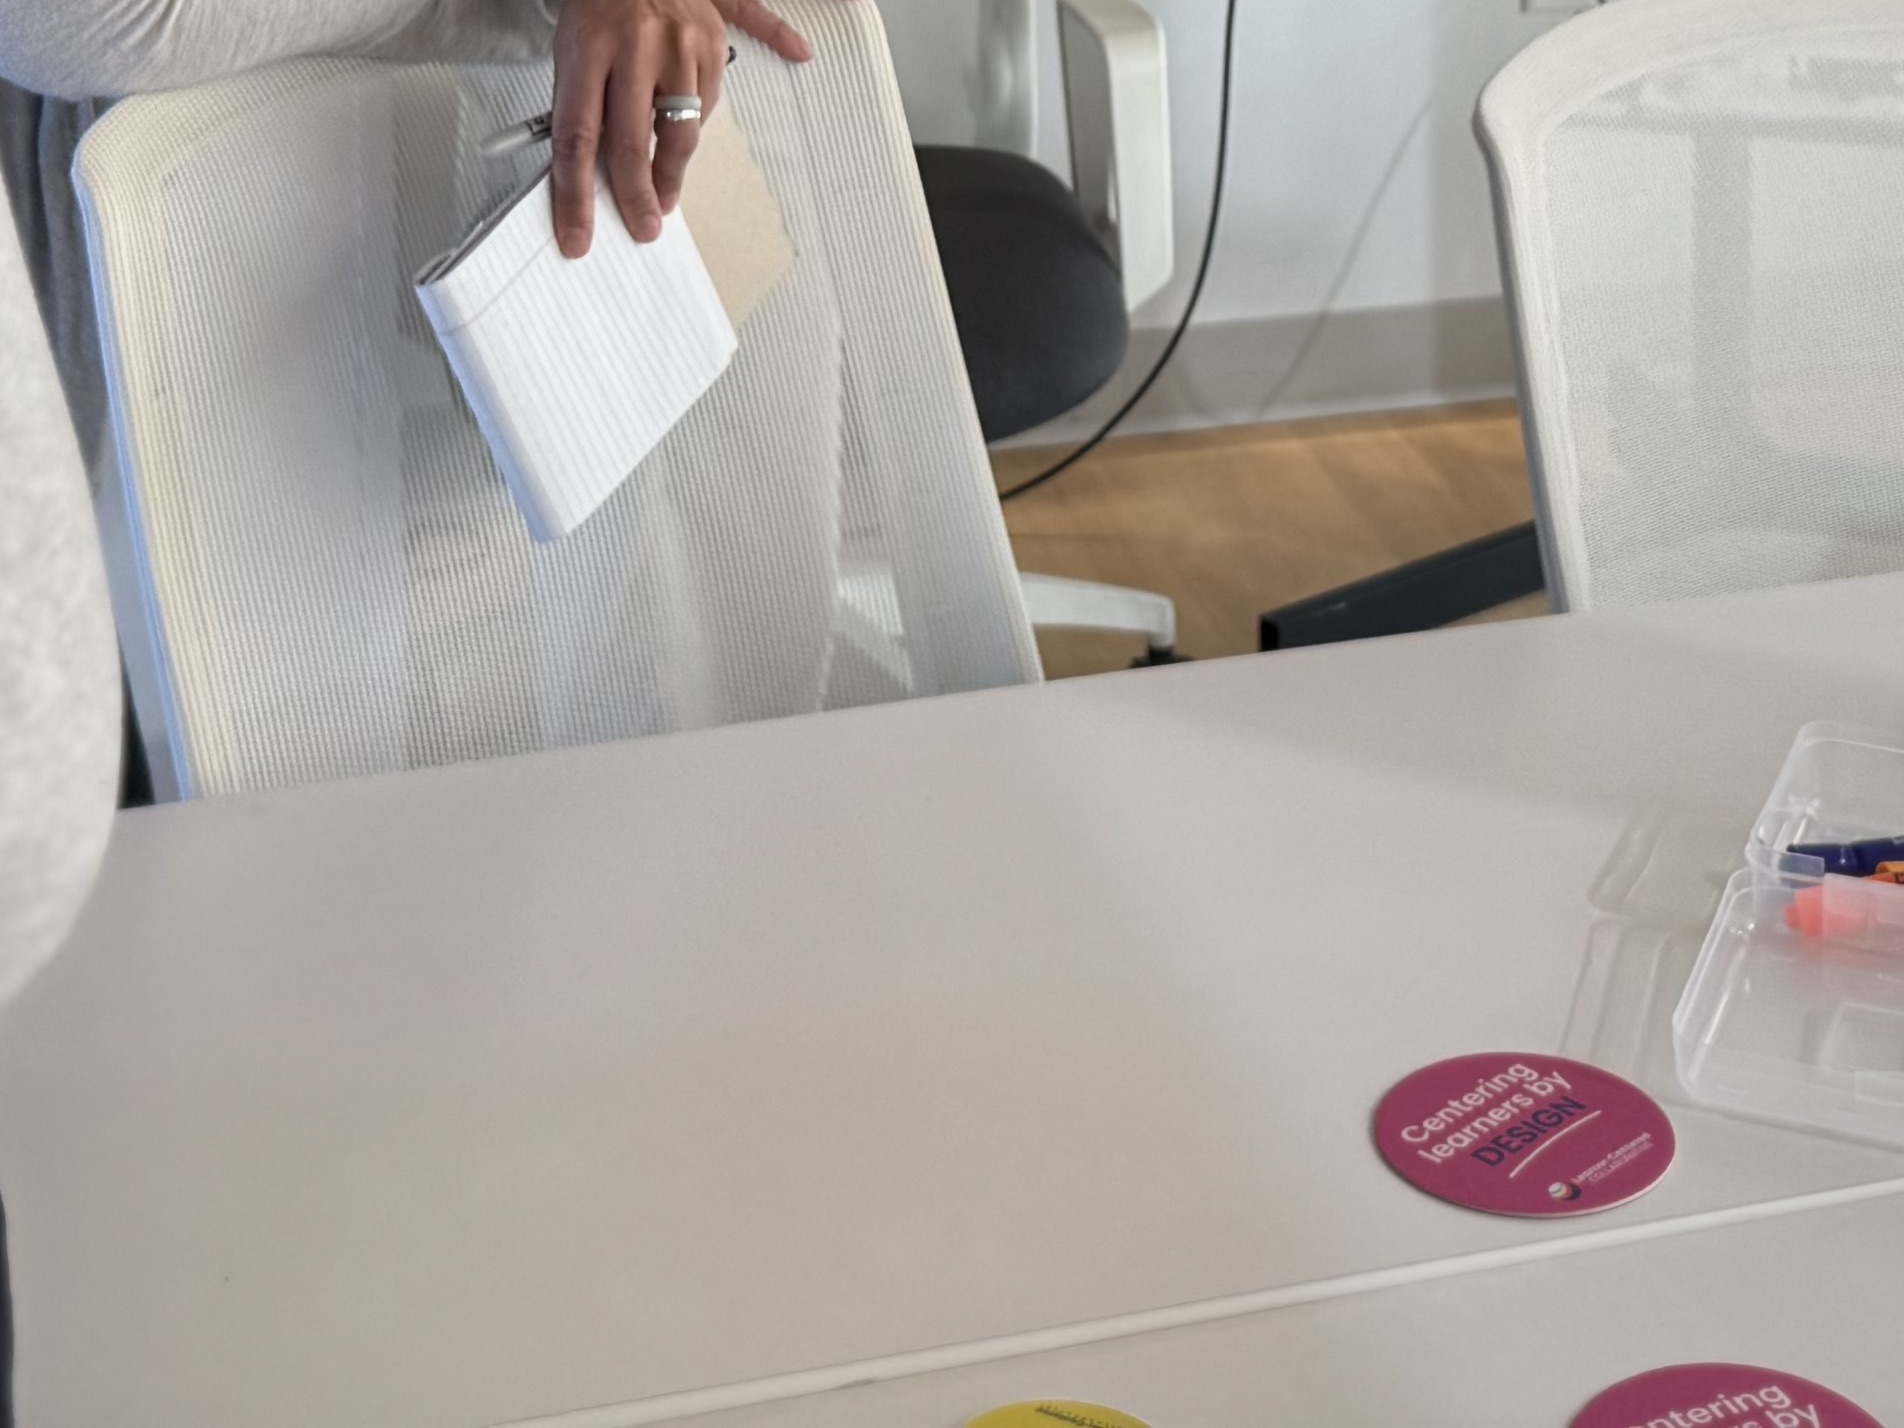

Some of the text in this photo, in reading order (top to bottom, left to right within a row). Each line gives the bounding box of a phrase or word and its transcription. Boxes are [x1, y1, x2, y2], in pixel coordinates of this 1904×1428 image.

[1400, 1063, 1540, 1143] Centering
[1417, 1070, 1572, 1164] learners by
[1471, 1095, 1588, 1167] DESIGN
